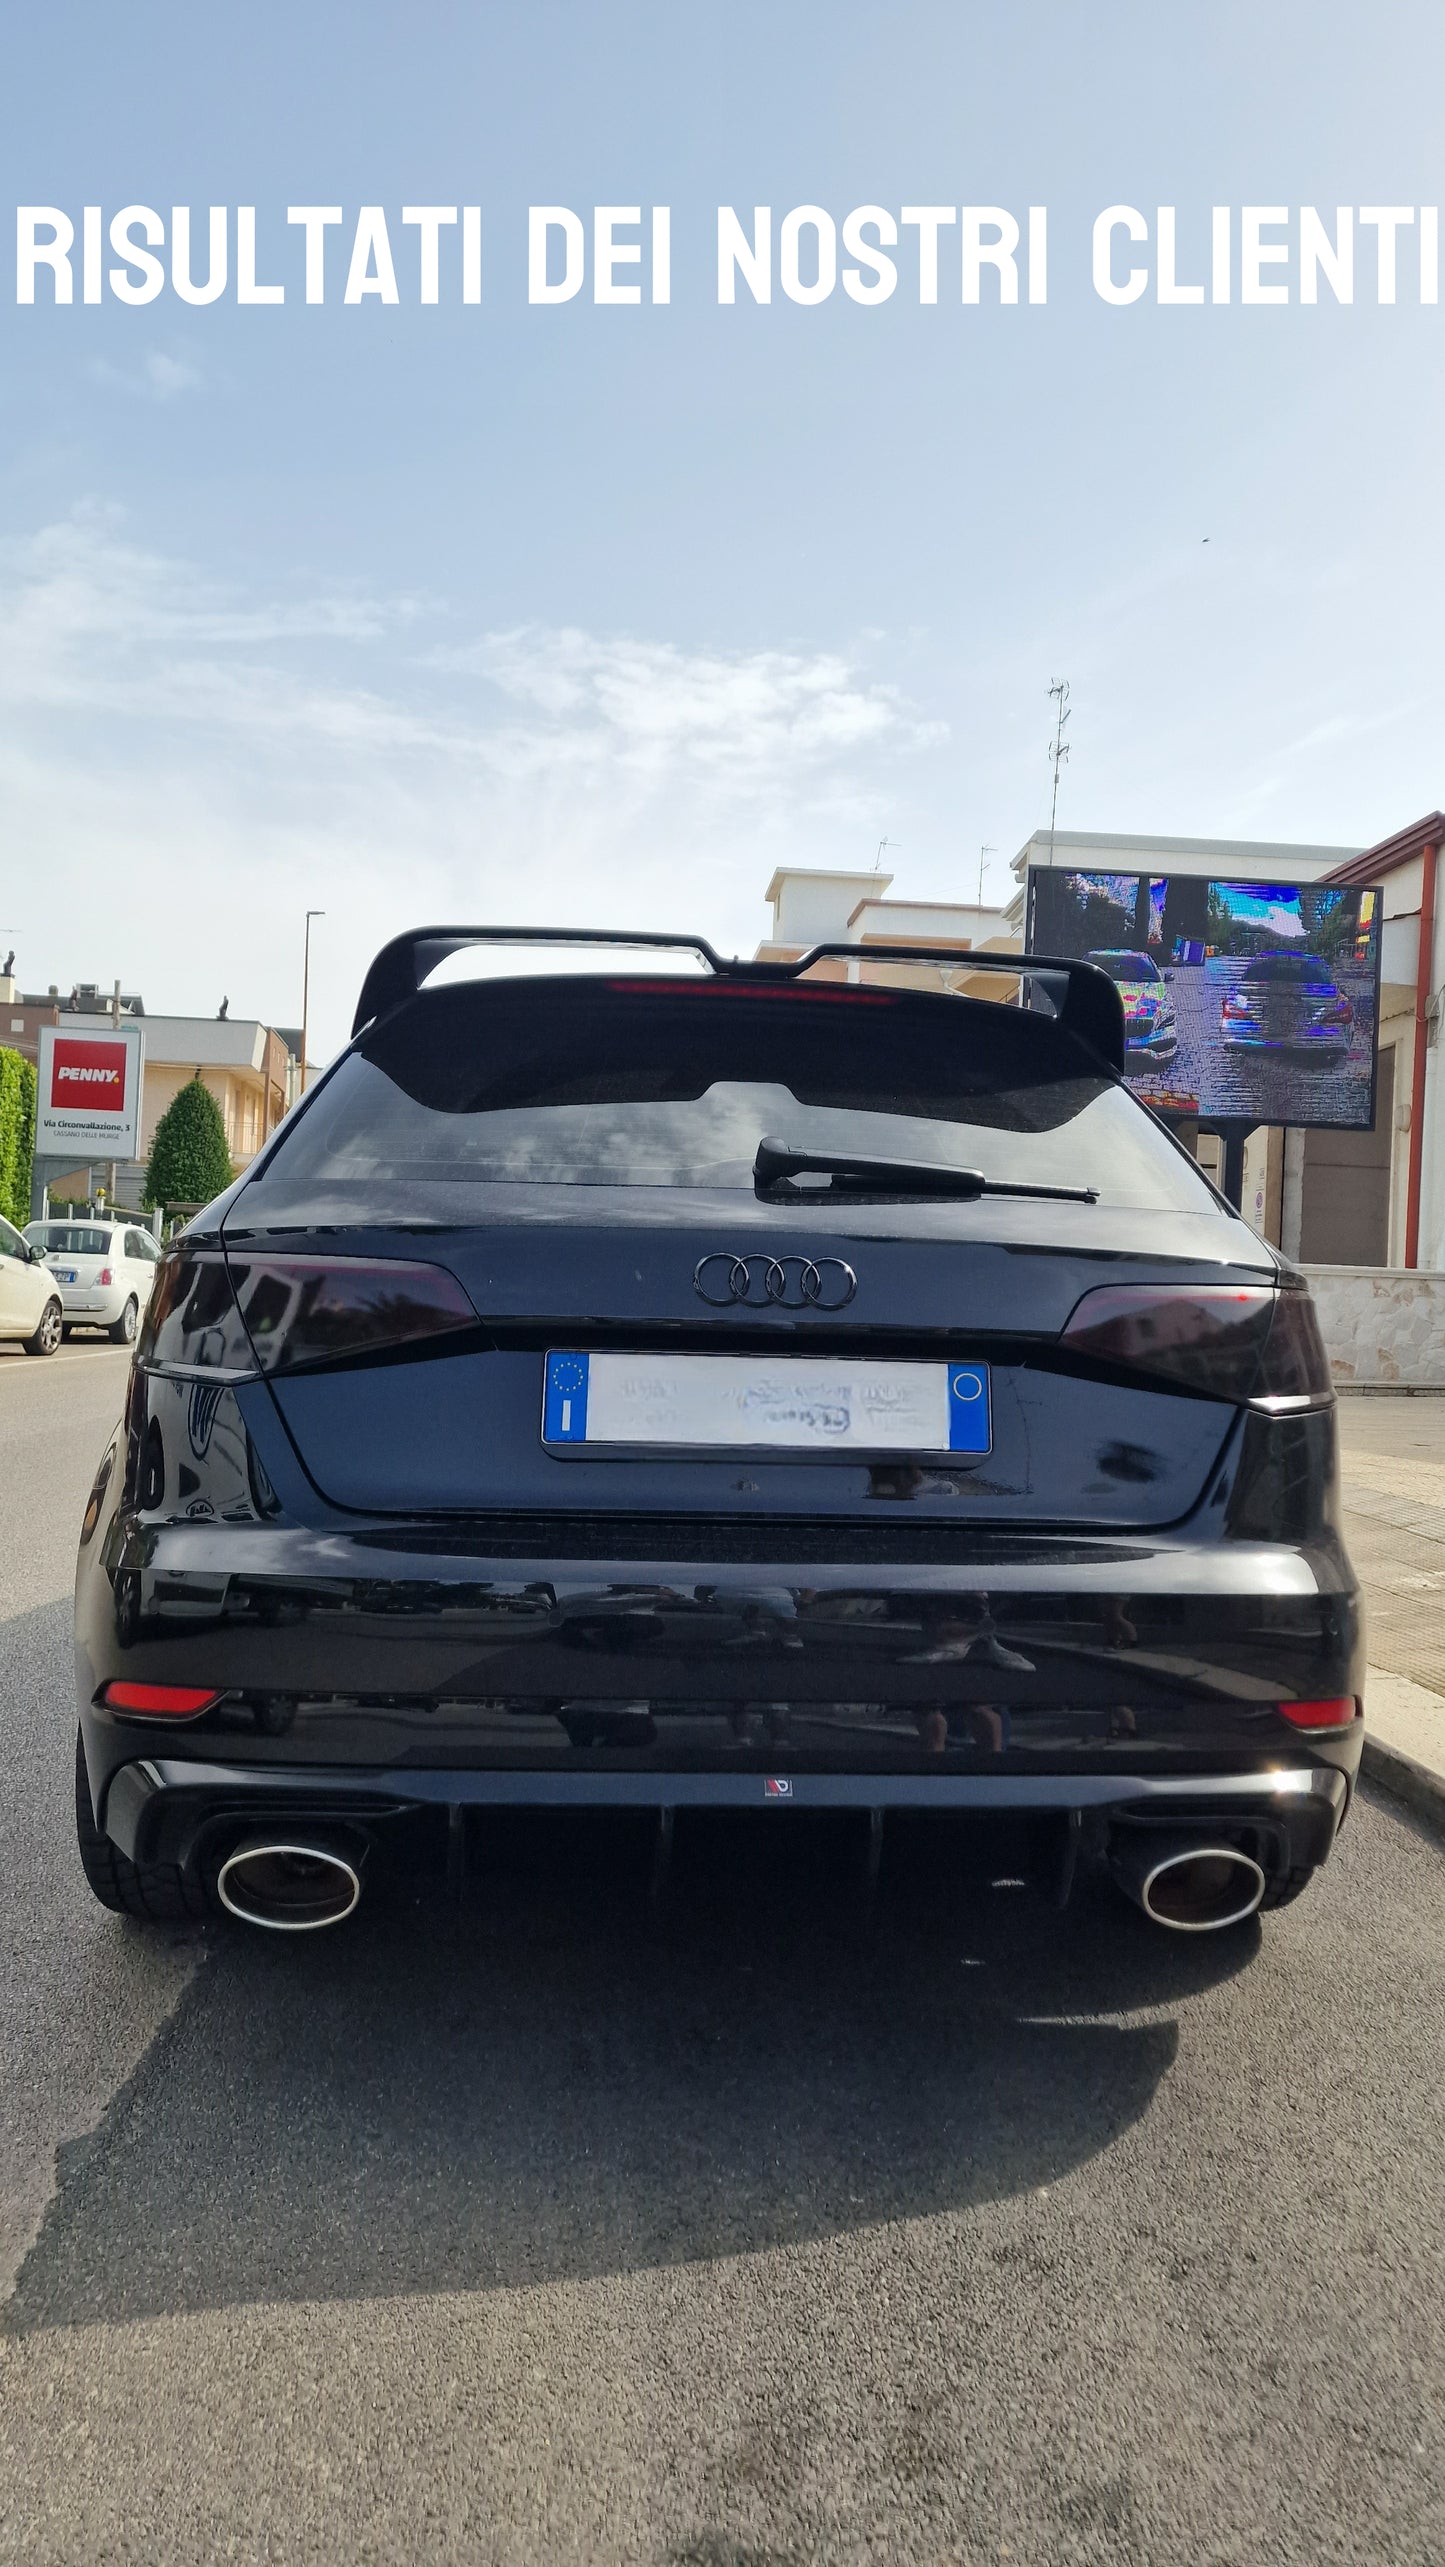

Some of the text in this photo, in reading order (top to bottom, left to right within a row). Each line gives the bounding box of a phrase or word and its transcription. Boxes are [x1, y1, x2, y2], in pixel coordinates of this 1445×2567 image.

[43, 1119, 131, 1132] Via Circonvallazione, 3
[53, 1130, 80, 1138] CASSANO
[81, 1131, 97, 1139] DELLE
